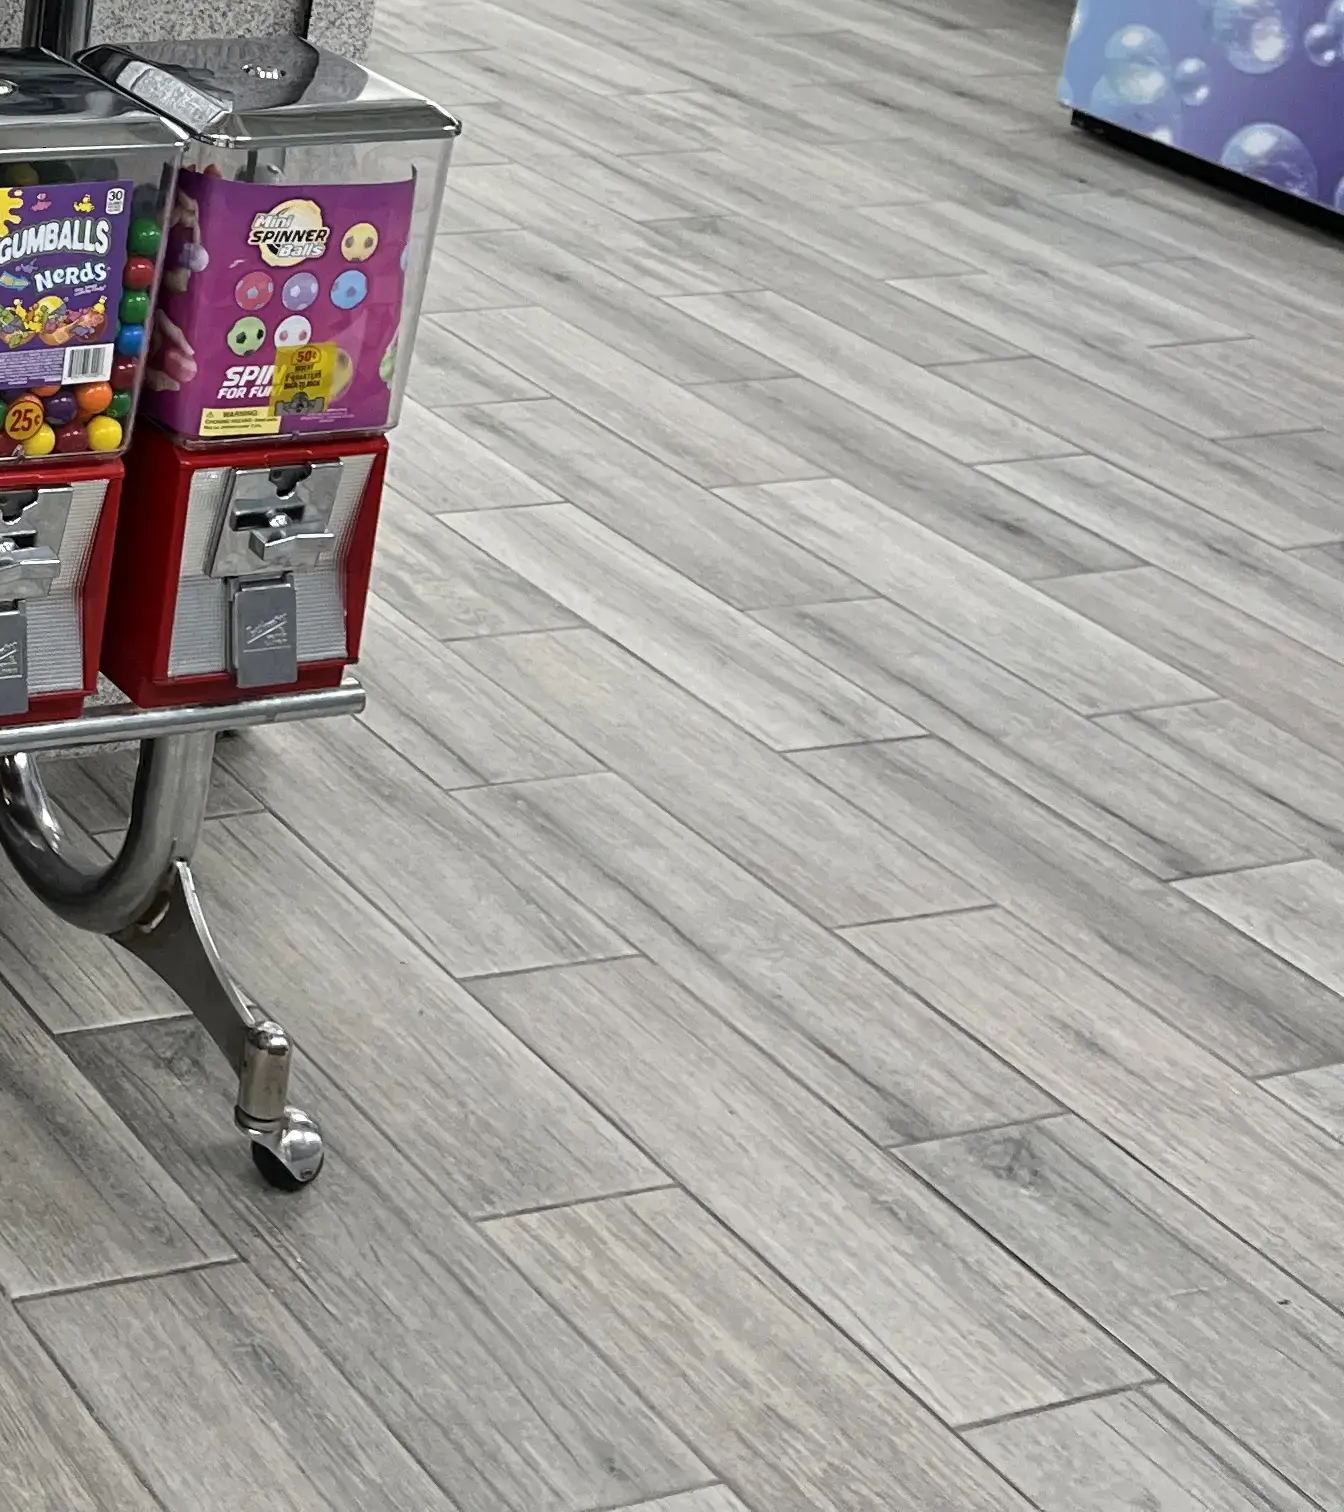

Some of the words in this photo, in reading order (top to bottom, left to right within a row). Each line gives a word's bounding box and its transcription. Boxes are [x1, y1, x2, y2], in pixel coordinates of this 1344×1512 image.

[109, 190, 123, 202] 30
[253, 214, 295, 229] Mini
[250, 229, 328, 243] SPINNER
[277, 243, 325, 258] Balls
[296, 350, 318, 363] 50¢
[223, 365, 288, 387] SPIN
[217, 387, 247, 400] FOR
[9, 409, 42, 433] 25¢
